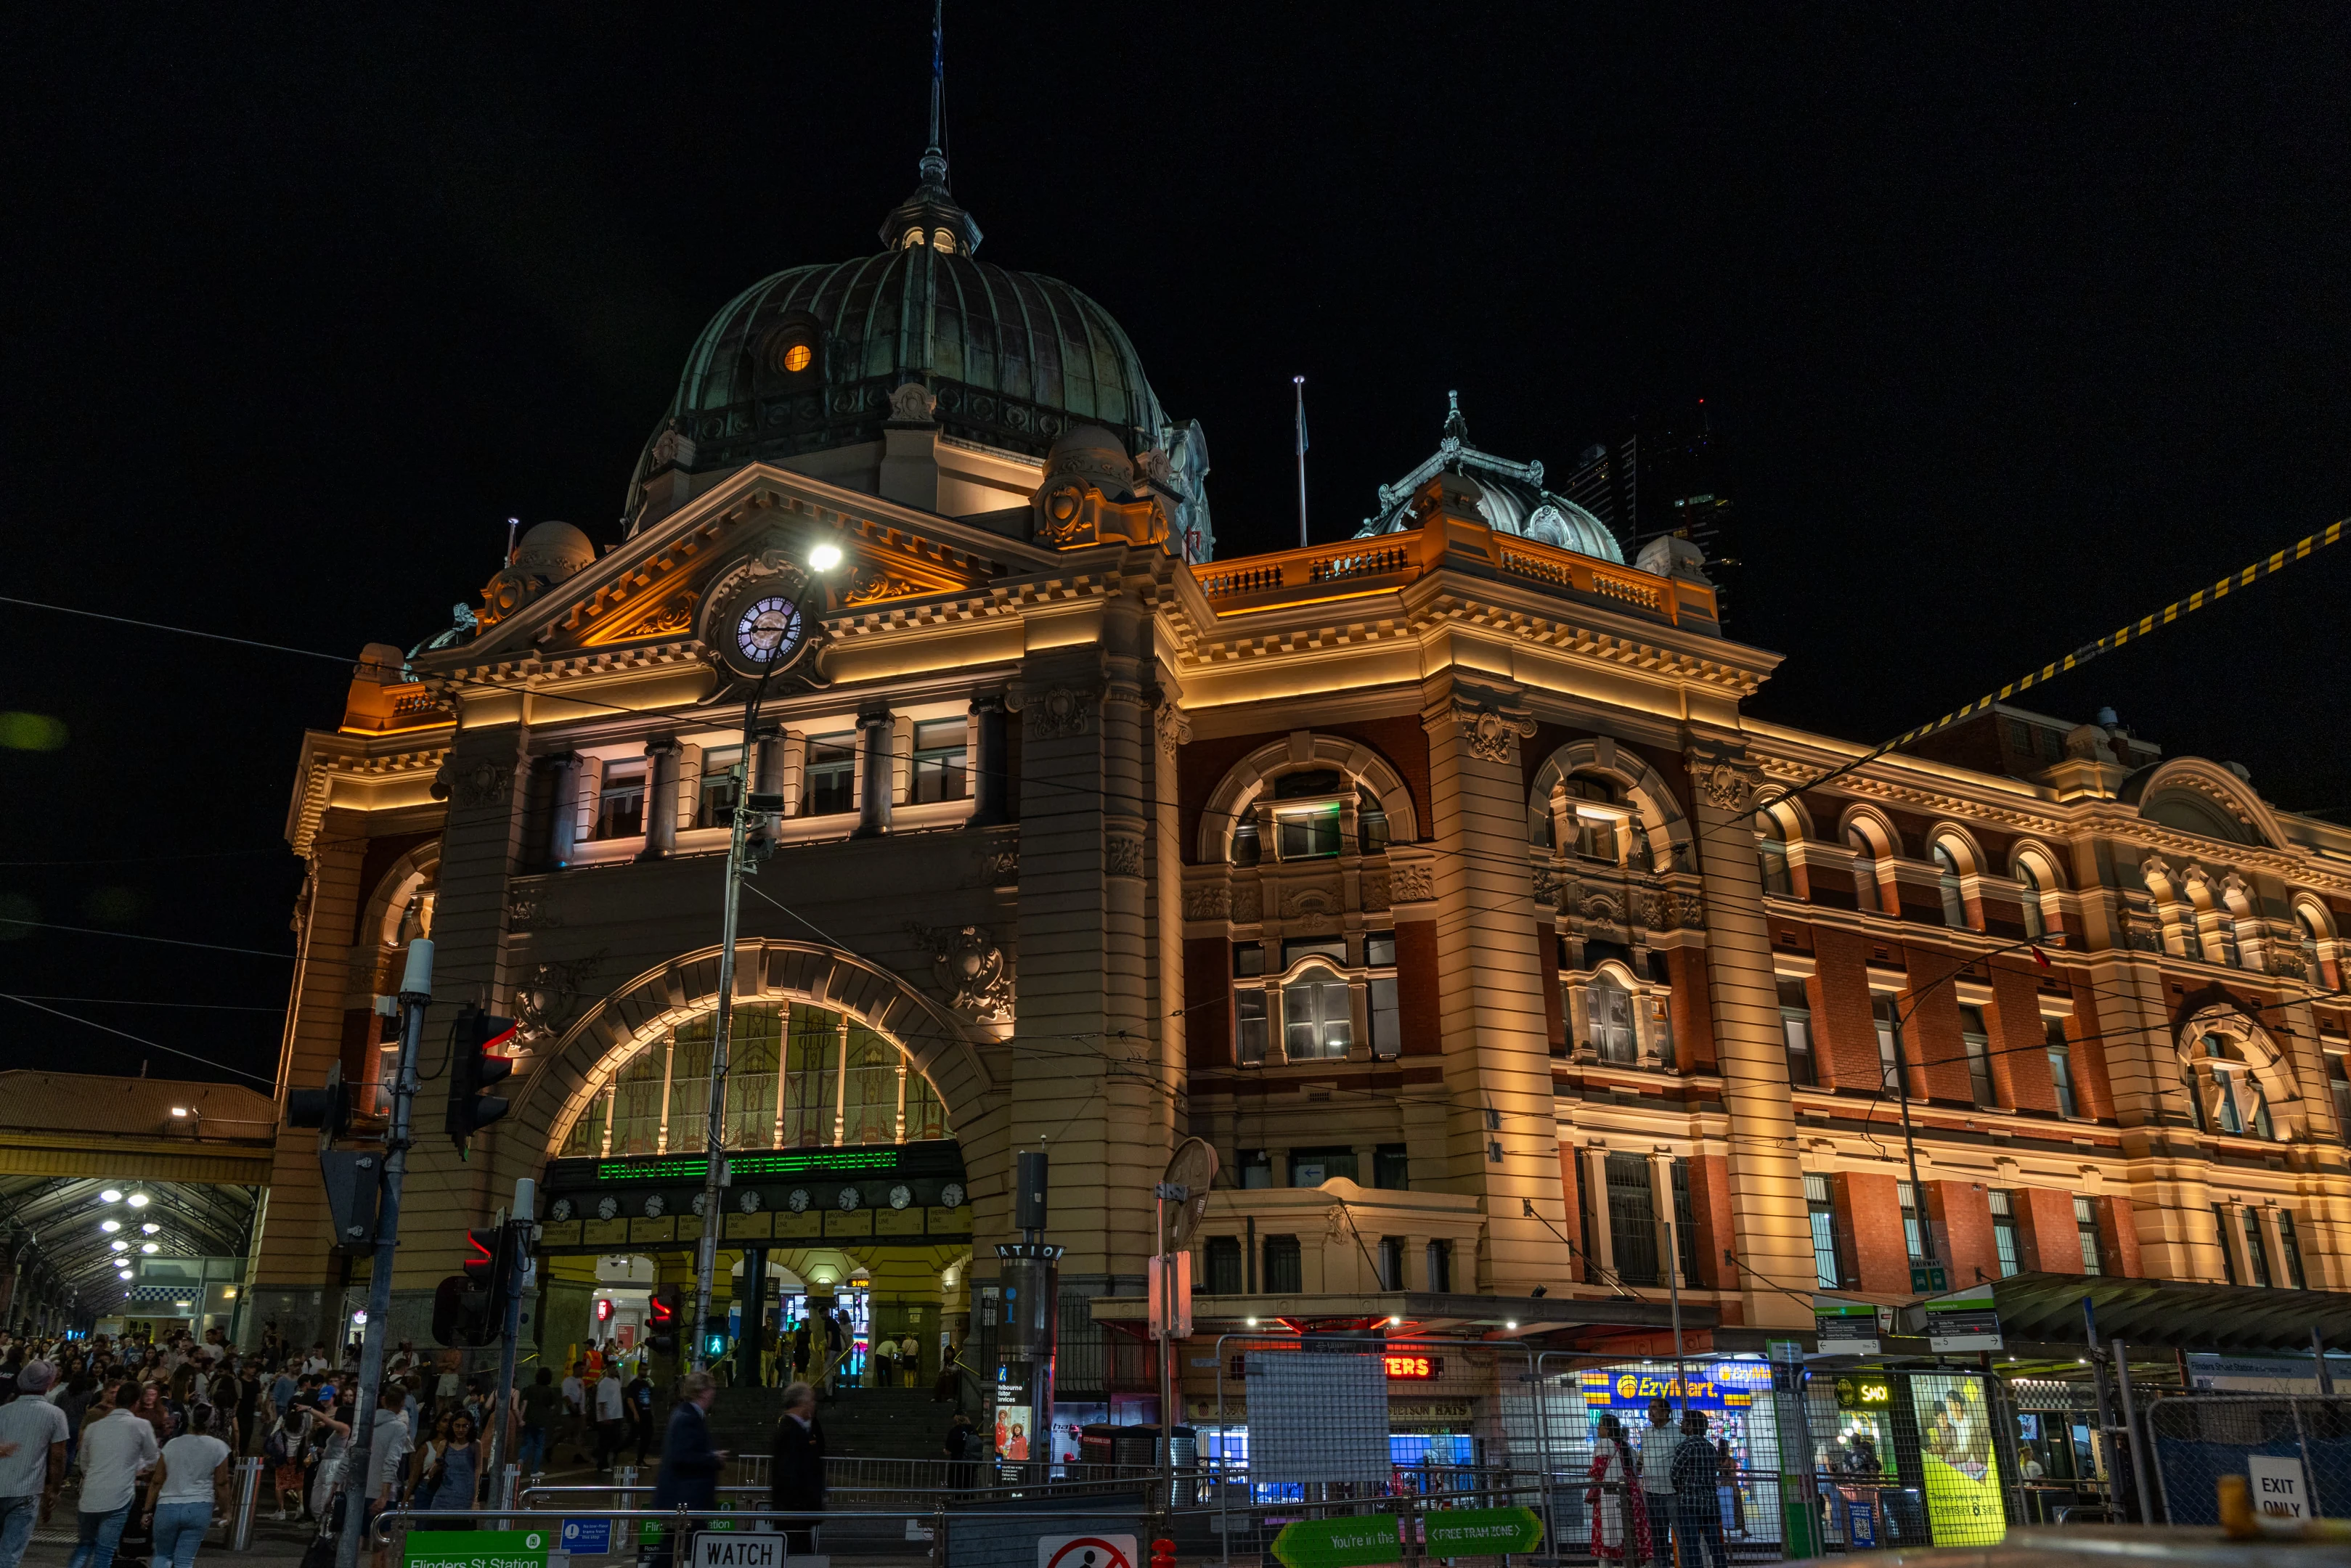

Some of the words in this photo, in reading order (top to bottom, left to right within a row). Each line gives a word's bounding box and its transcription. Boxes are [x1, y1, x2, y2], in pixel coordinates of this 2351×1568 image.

[735, 1157, 778, 1174] REET
[804, 1151, 892, 1169] STATION
[1872, 1340, 1878, 1349] 5
[1944, 1337, 1949, 1346] 5
[2191, 1361, 2214, 1371] Flinders
[2233, 1363, 2254, 1372] Station
[1731, 1366, 1772, 1383] EzyMa
[1388, 1405, 1430, 1416] STETSON
[1435, 1405, 1467, 1416] HATS
[2261, 1477, 2294, 1494] EXIT
[1930, 1493, 1954, 1501] There's
[1955, 1493, 1968, 1503] only
[1935, 1506, 1970, 1515] CommBank
[1982, 1505, 1996, 1514] Safe
[2263, 1500, 2300, 1518] ONLY
[1438, 1527, 1462, 1540] FREE
[1463, 1527, 1488, 1538] TRAM
[1490, 1524, 1513, 1537] ZONE
[1332, 1535, 1364, 1549] You're
[1365, 1533, 1375, 1545] in
[1377, 1530, 1395, 1545] the
[707, 1543, 773, 1566] WATCH
[410, 1559, 467, 1568] Flinders
[470, 1558, 486, 1568] St
[490, 1557, 539, 1568] Station
